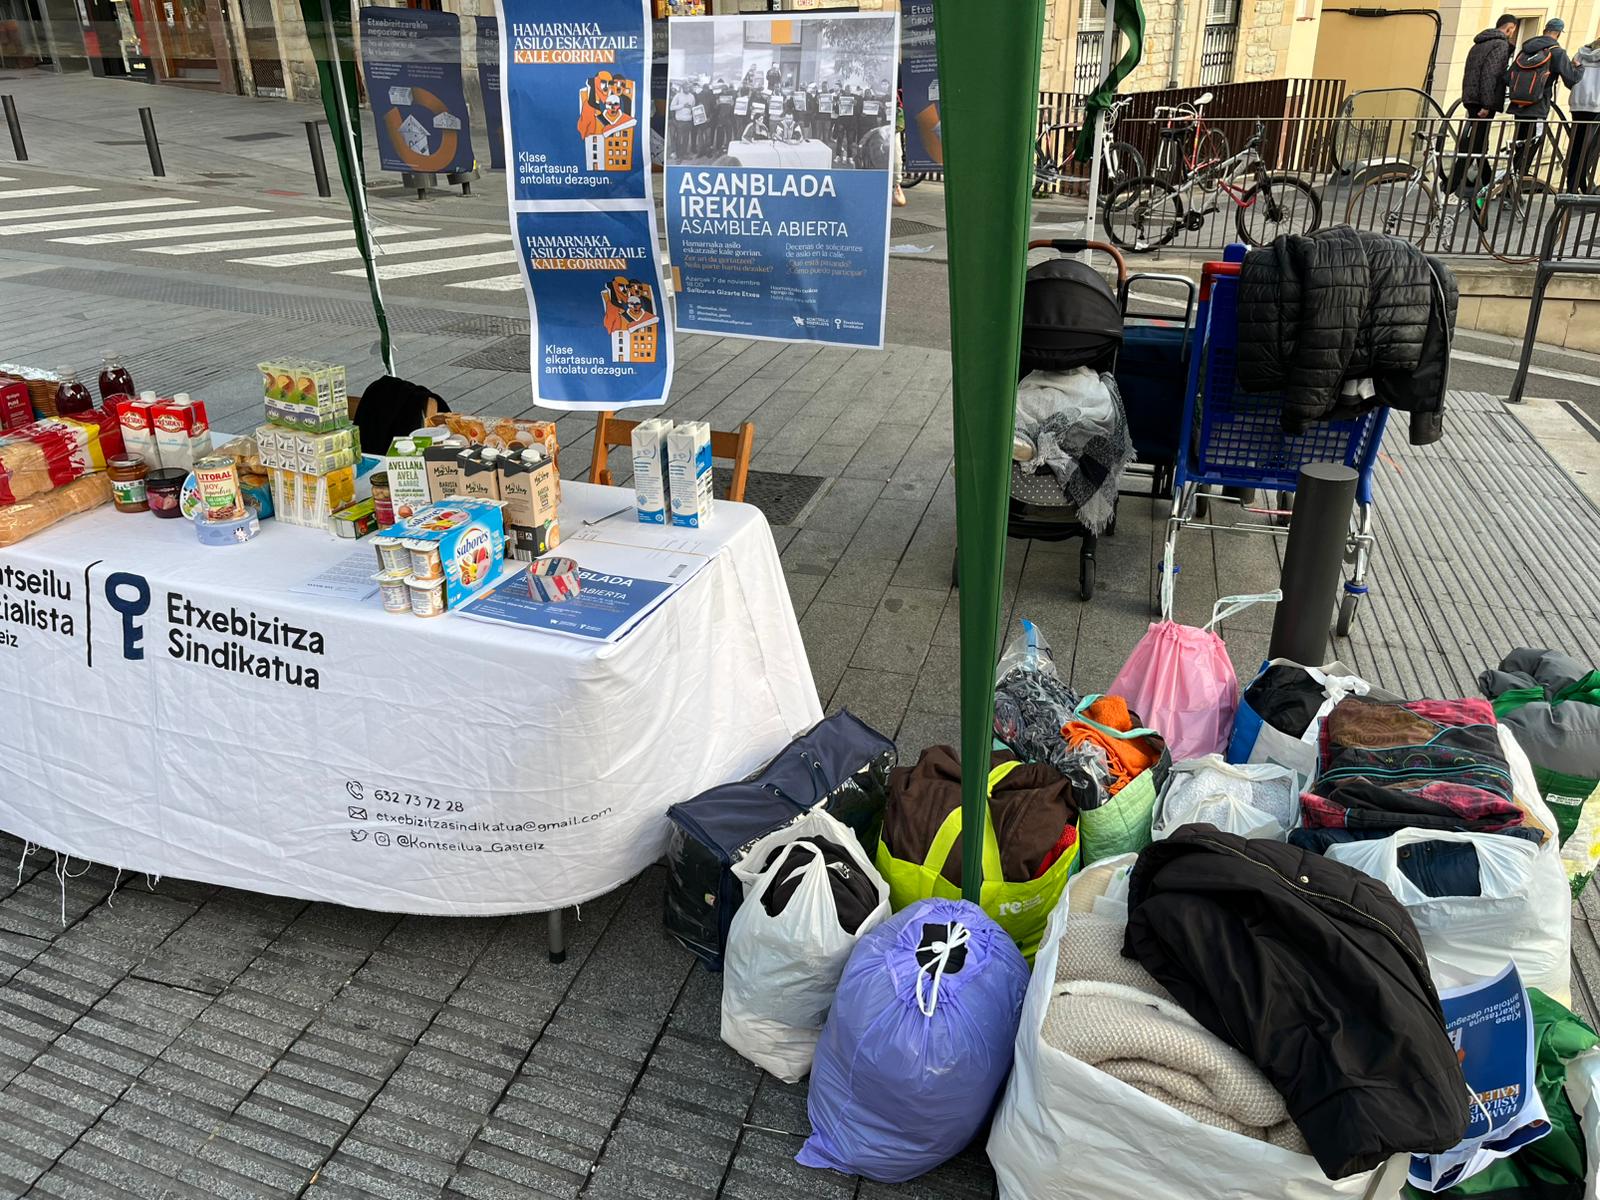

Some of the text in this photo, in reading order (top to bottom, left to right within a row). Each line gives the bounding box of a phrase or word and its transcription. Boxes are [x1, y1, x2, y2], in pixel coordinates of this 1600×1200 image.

[513, 22, 601, 36] HAMARNAKA
[514, 36, 638, 50] ASILO ESKATZAILE
[515, 50, 614, 63] KALE GORRIAN
[518, 151, 547, 162] Klase
[519, 163, 579, 173] elkartasuna
[520, 174, 562, 184] antolatu
[679, 172, 836, 197] ASANBLADA
[680, 196, 764, 218] IREKIA
[680, 219, 849, 238] ASAMBLEA ABIERTA
[526, 235, 611, 247] HAMARNAKA
[682, 240, 741, 249] Hamarnaka asilo
[785, 242, 815, 250] Decenas
[530, 247, 647, 258] ASILO ESKATZAILE
[719, 248, 734, 256] kale
[734, 249, 763, 257] gorrian.
[533, 259, 627, 270] KALE GORRIAN
[741, 290, 760, 298] Etxea
[545, 345, 573, 354] Klase
[545, 355, 605, 364] elkartasuna
[545, 365, 588, 374] antolatu
[388, 461, 424, 470] AVELLANA
[197, 471, 232, 480] LITORAL
[456, 530, 489, 558] sabores
[580, 587, 627, 600] ABIERTA
[167, 591, 325, 655] Etxebizitza
[167, 628, 320, 689] Sindikatua
[374, 789, 464, 813] 632 73 72 28
[376, 806, 612, 832] etxebizitzasindikatua@gmail.com
[1484, 993, 1520, 1014] antolatu
[1469, 1001, 1520, 1027] elkartasuna
[1495, 1010, 1521, 1024] Klase
